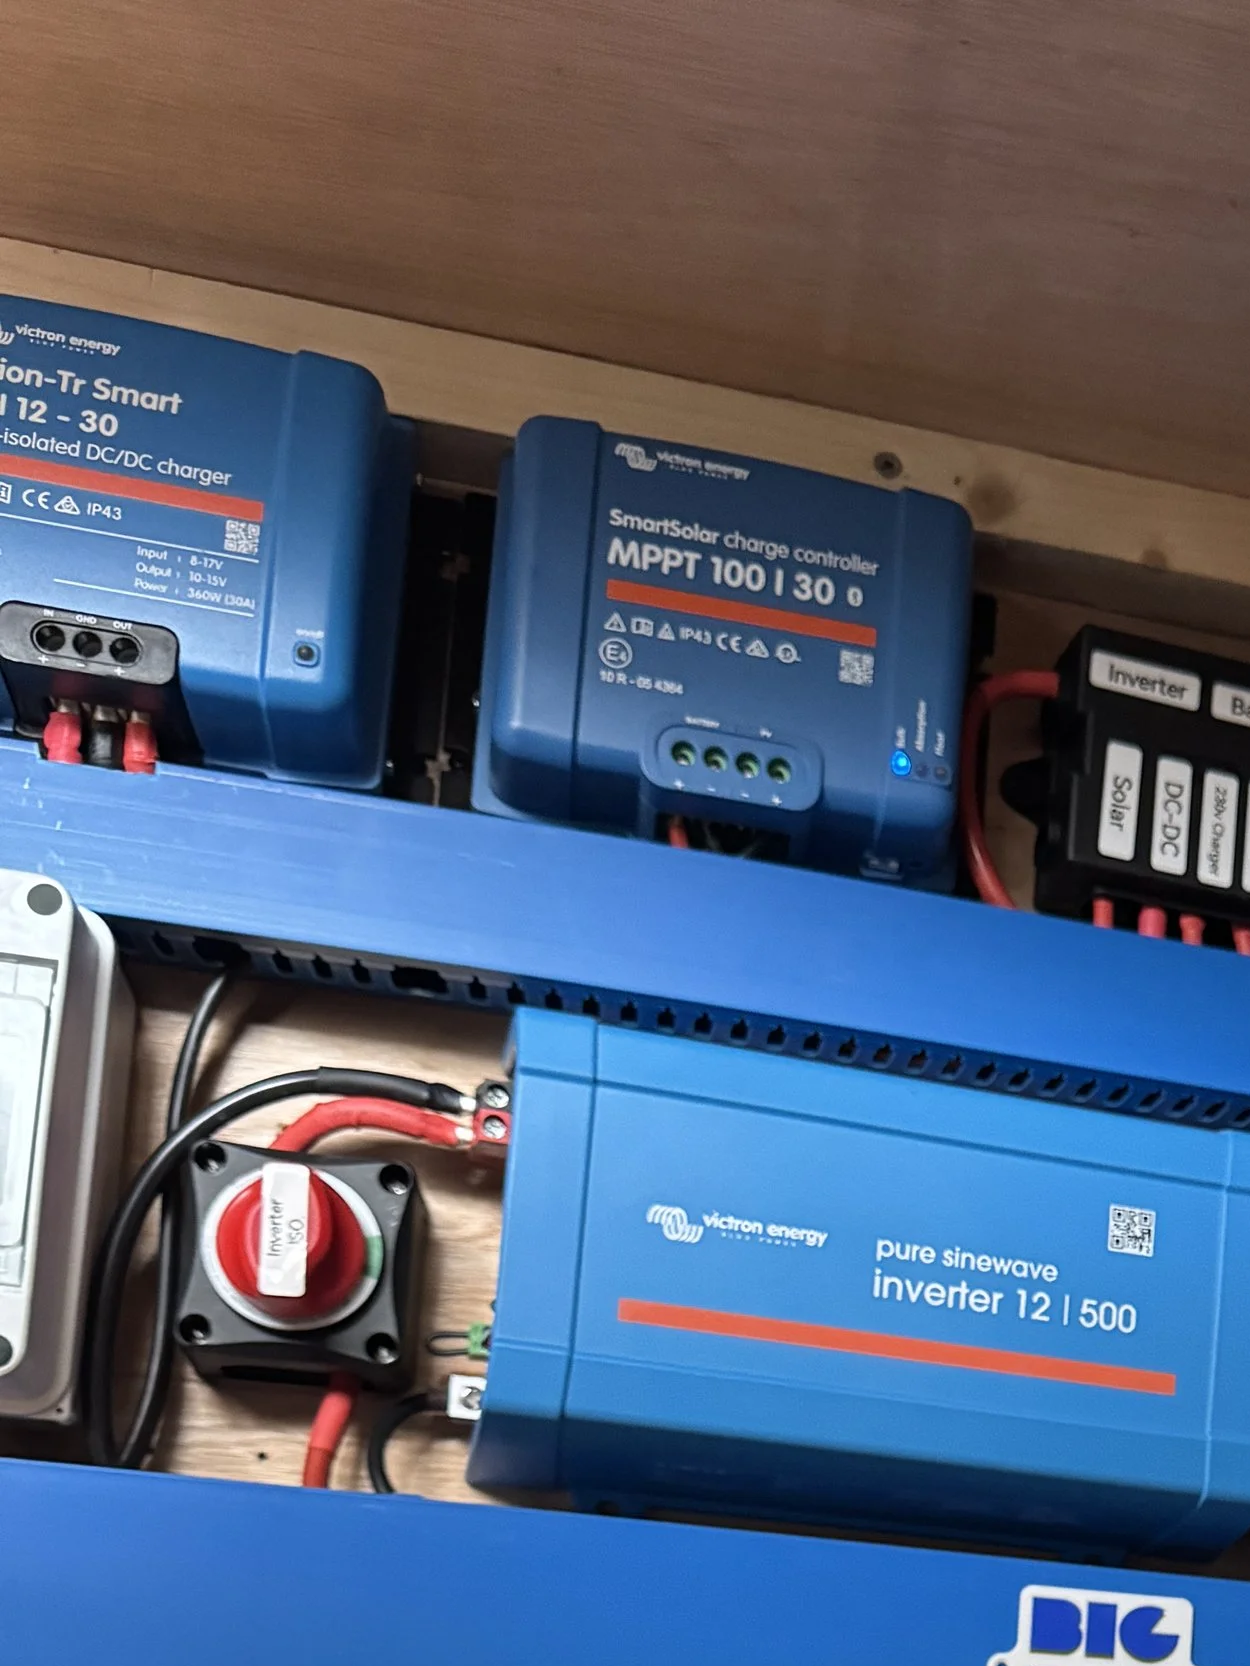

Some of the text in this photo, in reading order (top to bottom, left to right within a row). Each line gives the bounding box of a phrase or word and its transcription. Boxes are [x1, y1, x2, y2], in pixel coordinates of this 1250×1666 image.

[15, 324, 66, 343] victron
[69, 335, 121, 355] energy
[17, 396, 47, 424] 12
[79, 410, 119, 437] 30
[92, 378, 182, 414] Smart
[86, 443, 152, 471] DC/DC
[156, 457, 233, 486] charger
[86, 502, 122, 520] IP43
[137, 545, 168, 562] Input
[609, 508, 880, 577] SmartSolar charge controller
[606, 536, 703, 580] MPPT
[710, 555, 766, 593] 100
[792, 572, 836, 605] 30
[1108, 664, 1188, 701] Inverter
[1110, 775, 1133, 831] Solar
[1159, 781, 1184, 858] DC-DC
[1208, 823, 1225, 877] Charger
[267, 1198, 284, 1257] Inverter
[702, 1210, 763, 1235] victron
[766, 1223, 828, 1248] energy
[876, 1238, 1059, 1282] pure sinewave
[872, 1267, 1004, 1315] inverter
[1016, 1288, 1051, 1322] 12
[1078, 1298, 1137, 1334] 500
[1029, 1596, 1180, 1664] BIG
